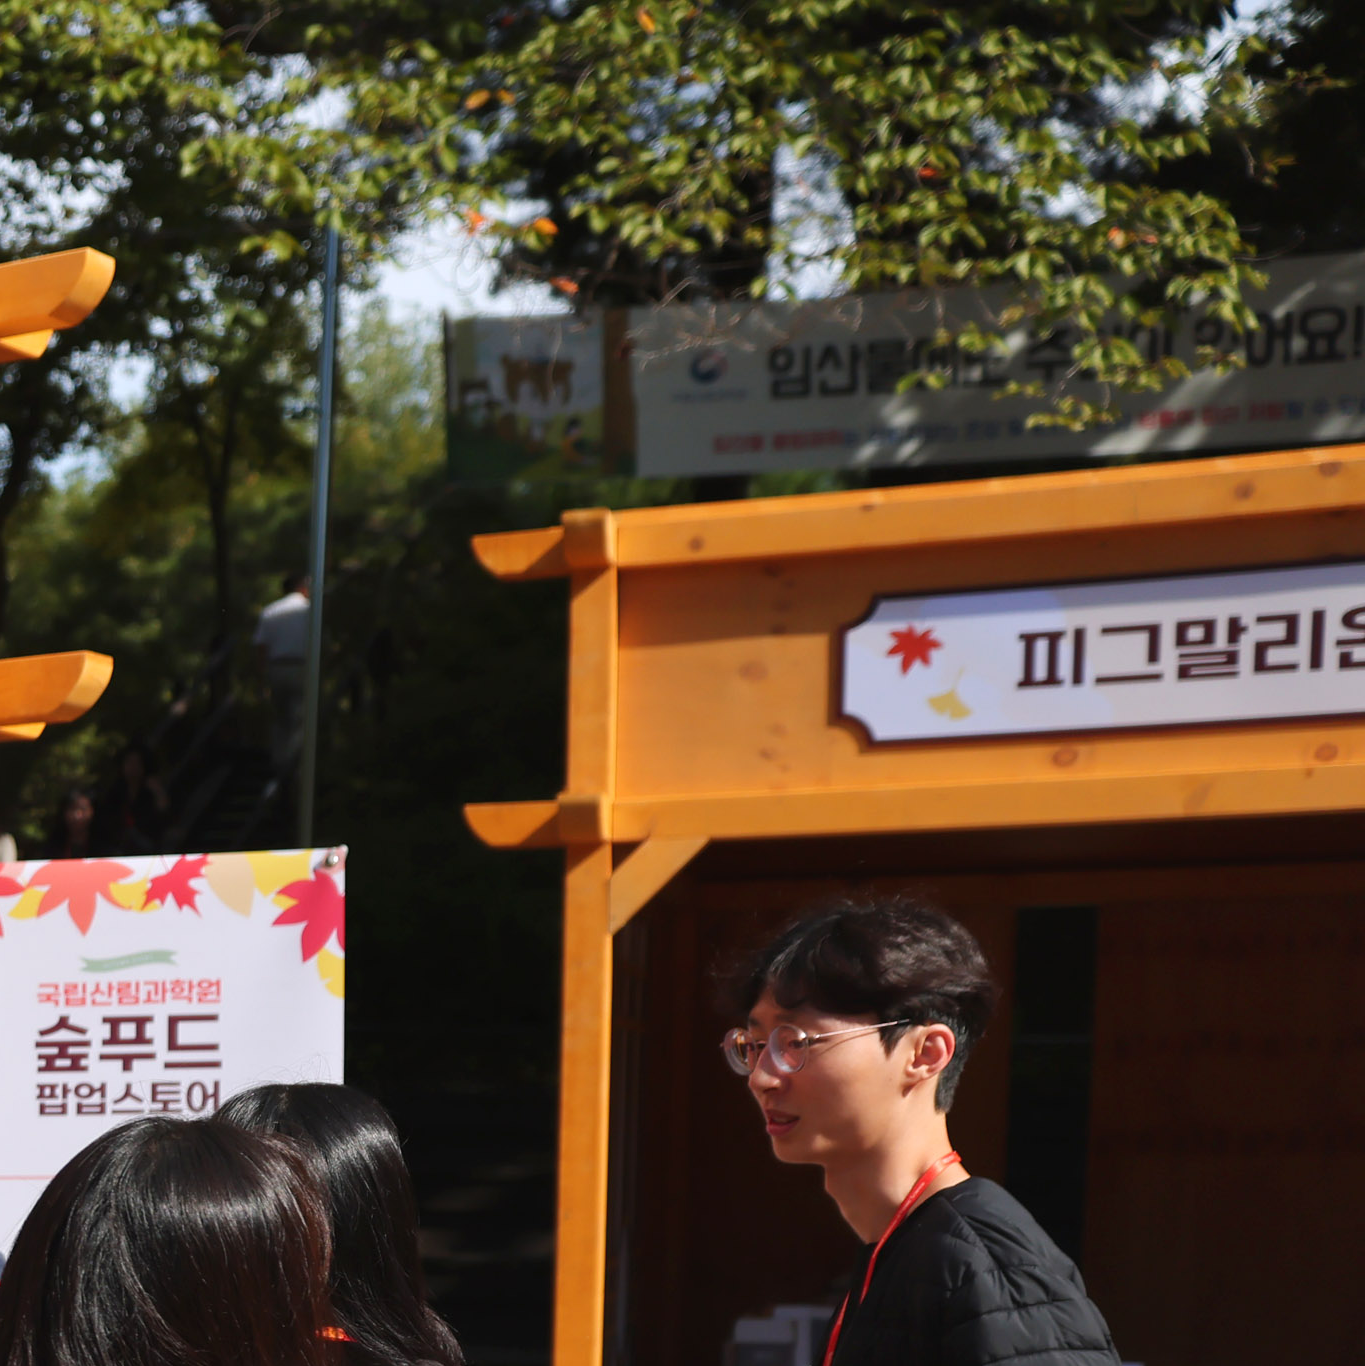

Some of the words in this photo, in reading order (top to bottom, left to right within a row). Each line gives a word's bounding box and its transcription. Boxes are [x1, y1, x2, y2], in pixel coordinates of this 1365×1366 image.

[36, 978, 222, 1008] 국립산림과학원
[35, 1014, 223, 1073] 숲푸드
[35, 1080, 221, 1117] 팝업스토어
